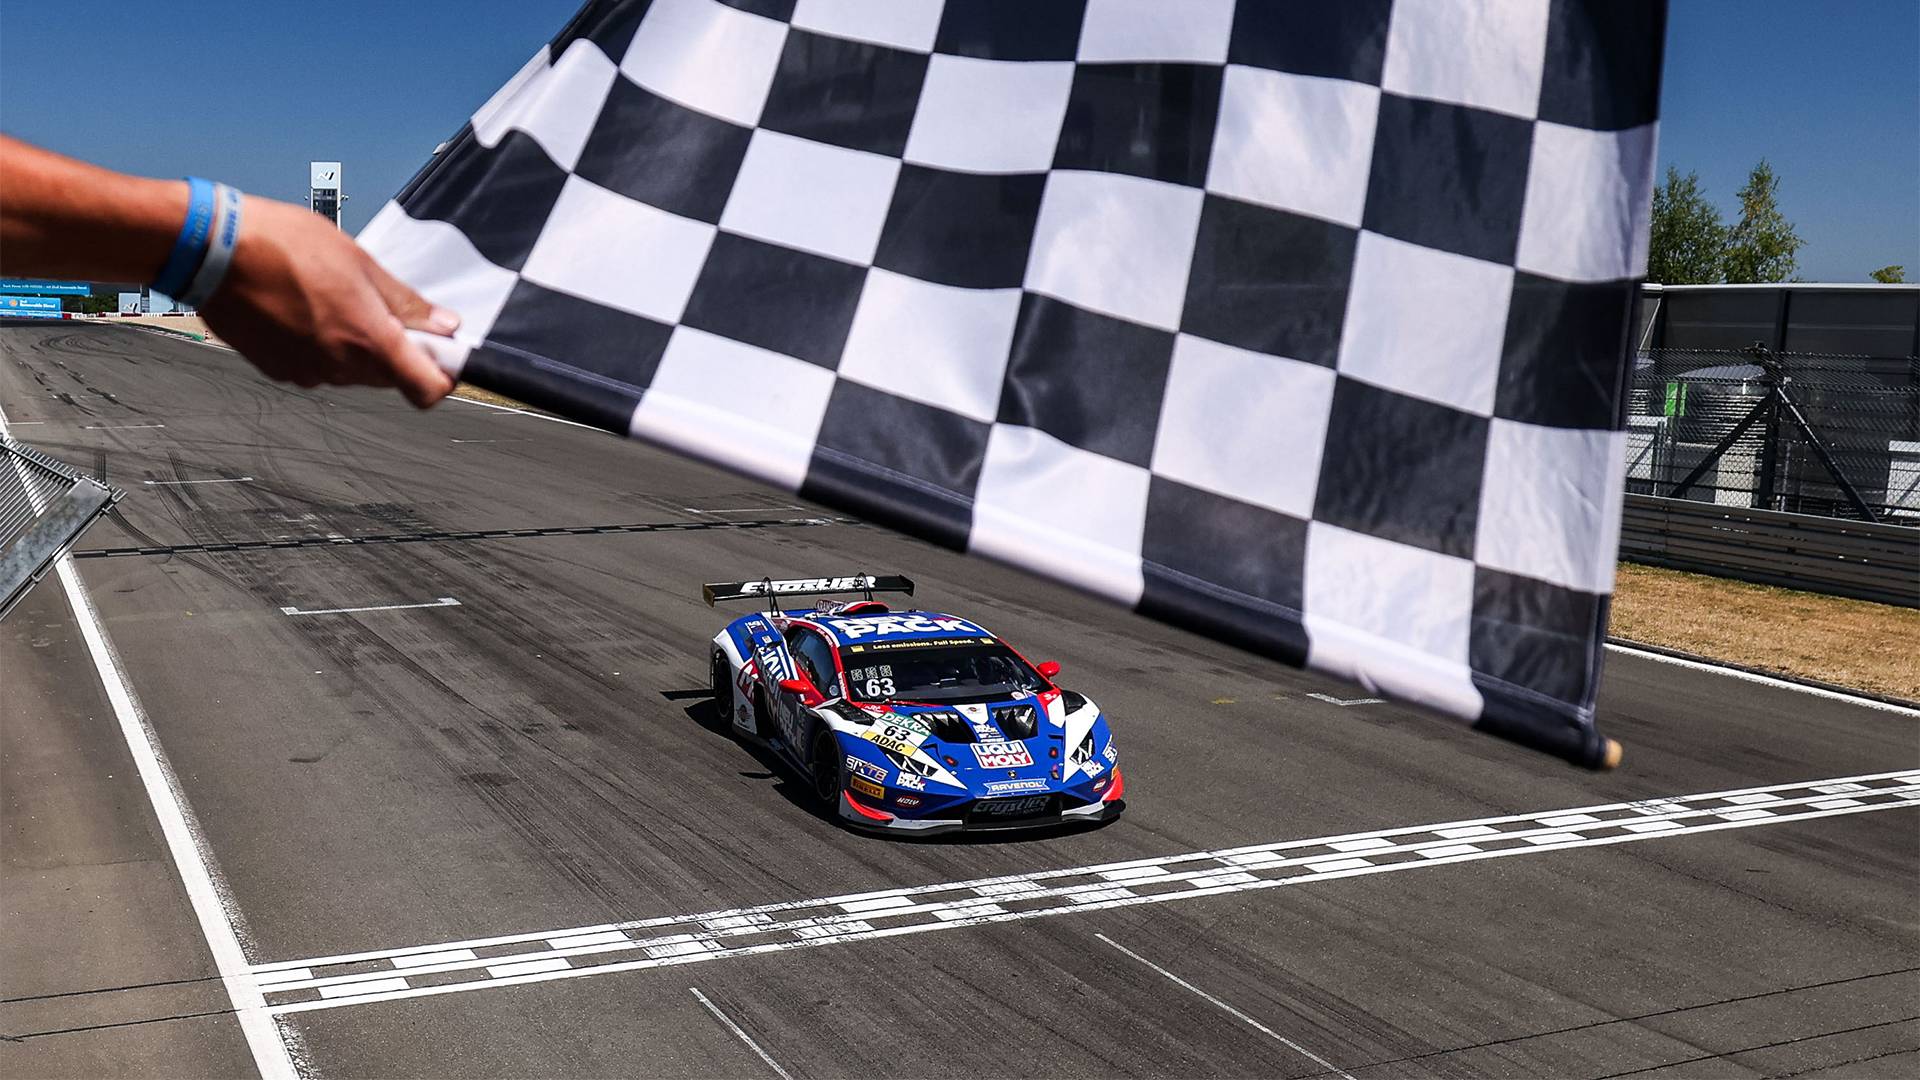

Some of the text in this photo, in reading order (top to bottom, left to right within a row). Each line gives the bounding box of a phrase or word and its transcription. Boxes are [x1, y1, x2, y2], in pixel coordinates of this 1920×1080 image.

[828, 615, 927, 629] NEU
[849, 620, 977, 639] PACK
[866, 678, 897, 697] 63
[881, 711, 931, 736] DEKRA
[884, 725, 911, 742] 63
[870, 734, 906, 752] ADAC
[974, 742, 1025, 756] LIQUI
[980, 753, 1028, 767] MOLY
[896, 777, 927, 792] PACK
[991, 781, 1041, 792] RAVENOL
